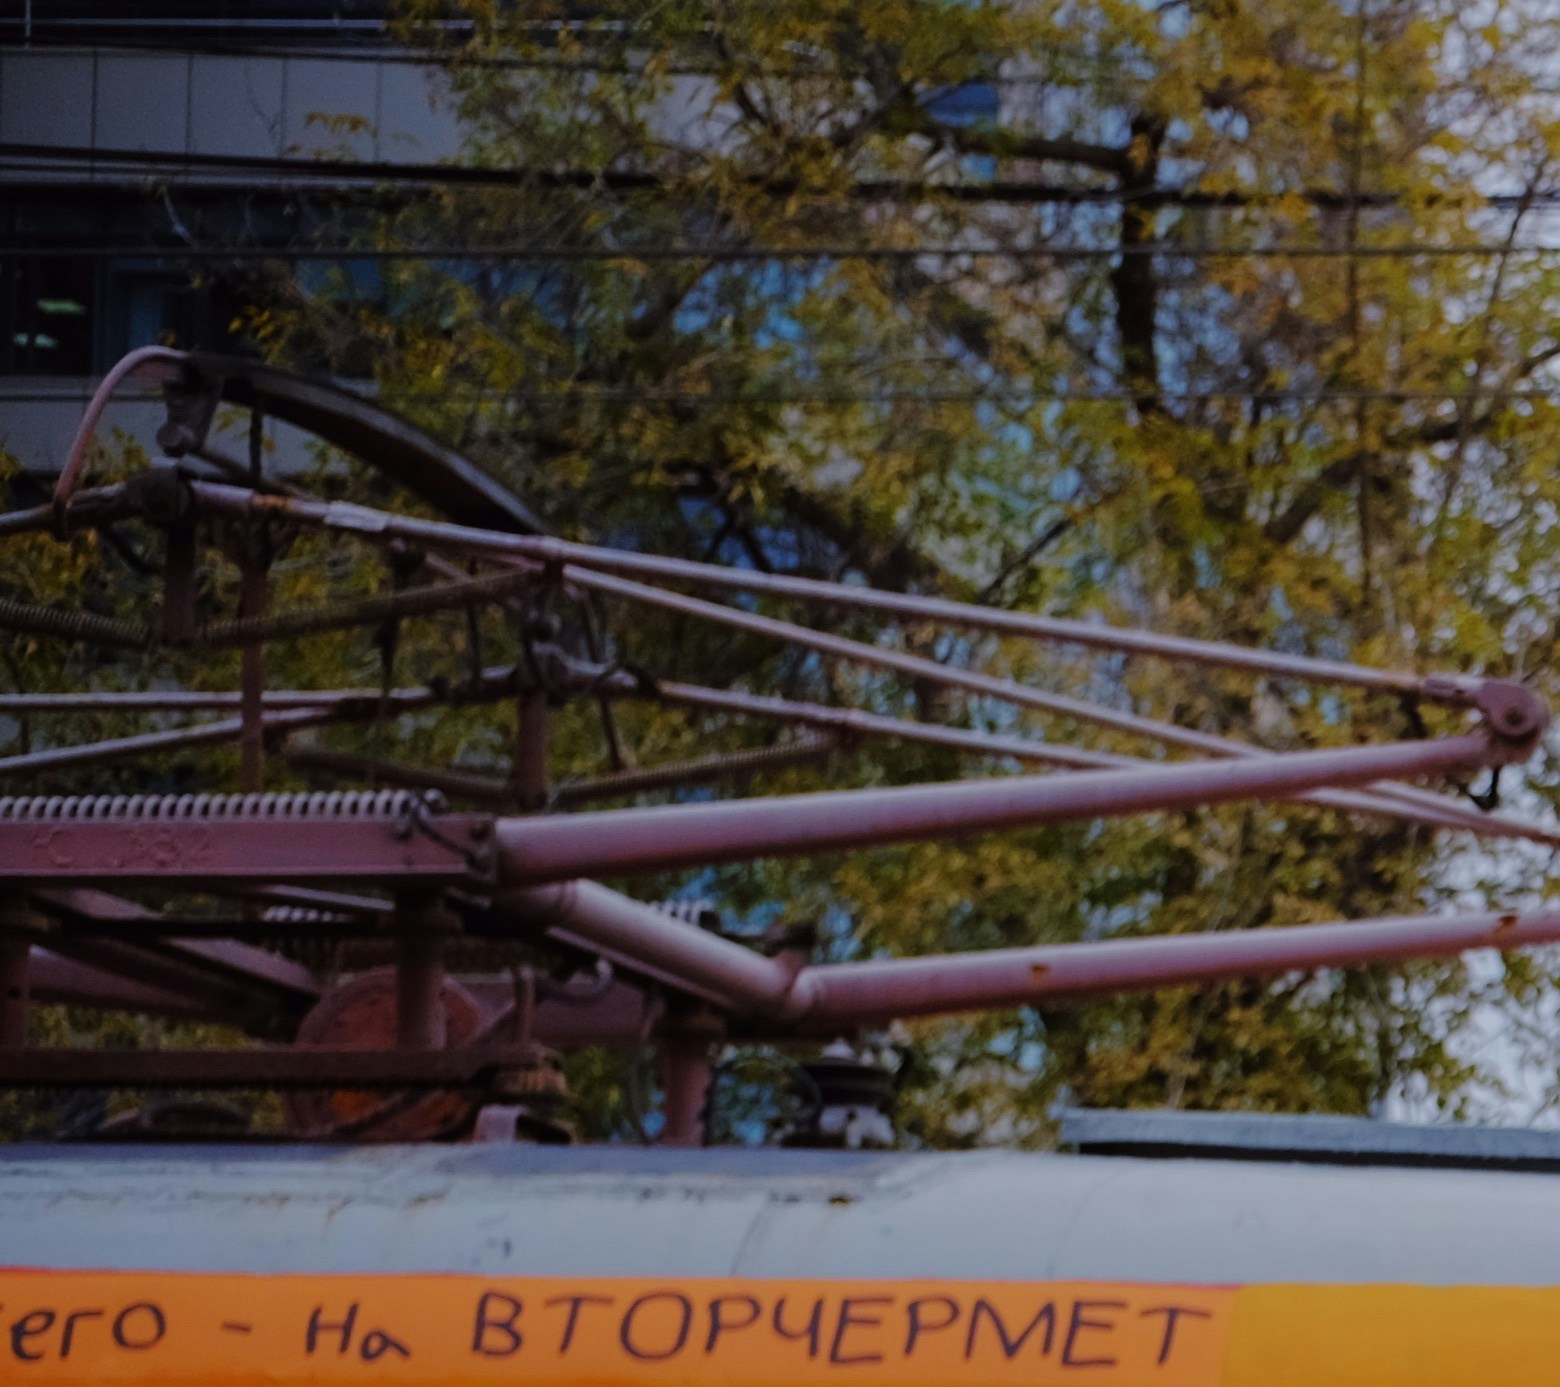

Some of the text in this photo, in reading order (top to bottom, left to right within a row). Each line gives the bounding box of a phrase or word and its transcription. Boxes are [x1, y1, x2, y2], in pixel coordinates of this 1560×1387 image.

[0, 1301, 167, 1363] его
[305, 1301, 411, 1361] На
[471, 1291, 1212, 1369] ВТОРЧЕРМЕТ
